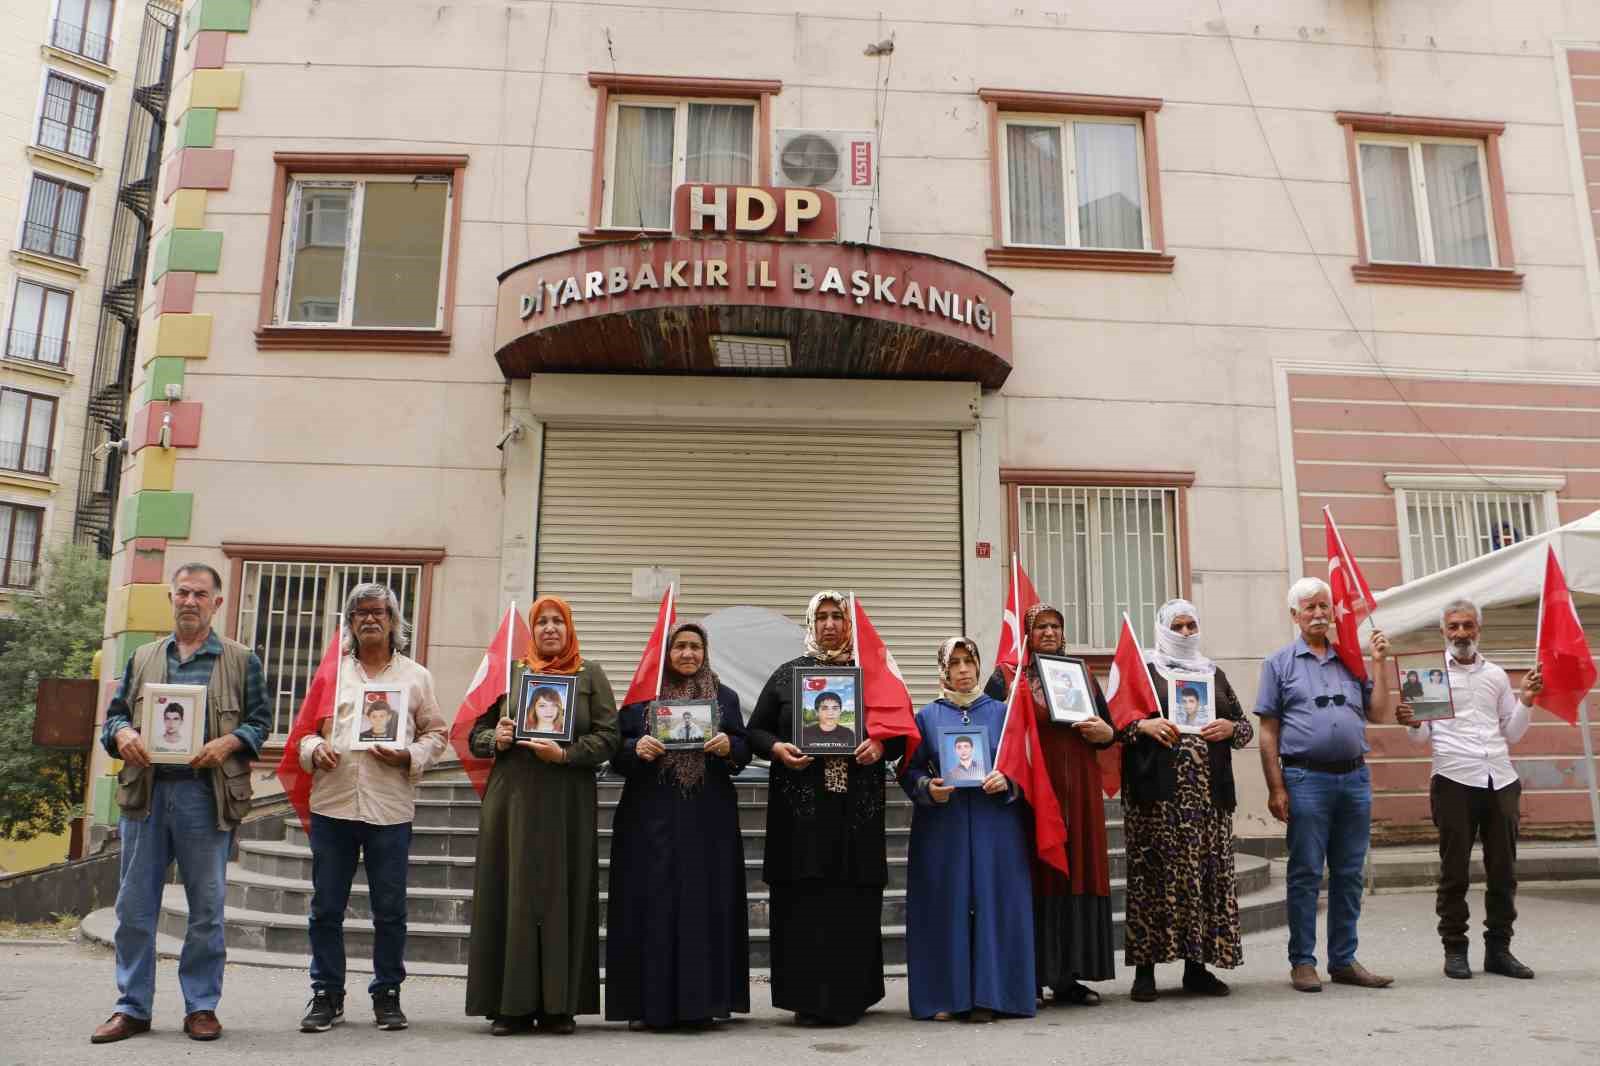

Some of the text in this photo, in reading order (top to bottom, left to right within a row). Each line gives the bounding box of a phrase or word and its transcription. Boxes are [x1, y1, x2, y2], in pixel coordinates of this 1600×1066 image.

[855, 142, 868, 186] VESTEL
[690, 186, 822, 233] HDP
[792, 263, 997, 336] BAŞKANLIĞI
